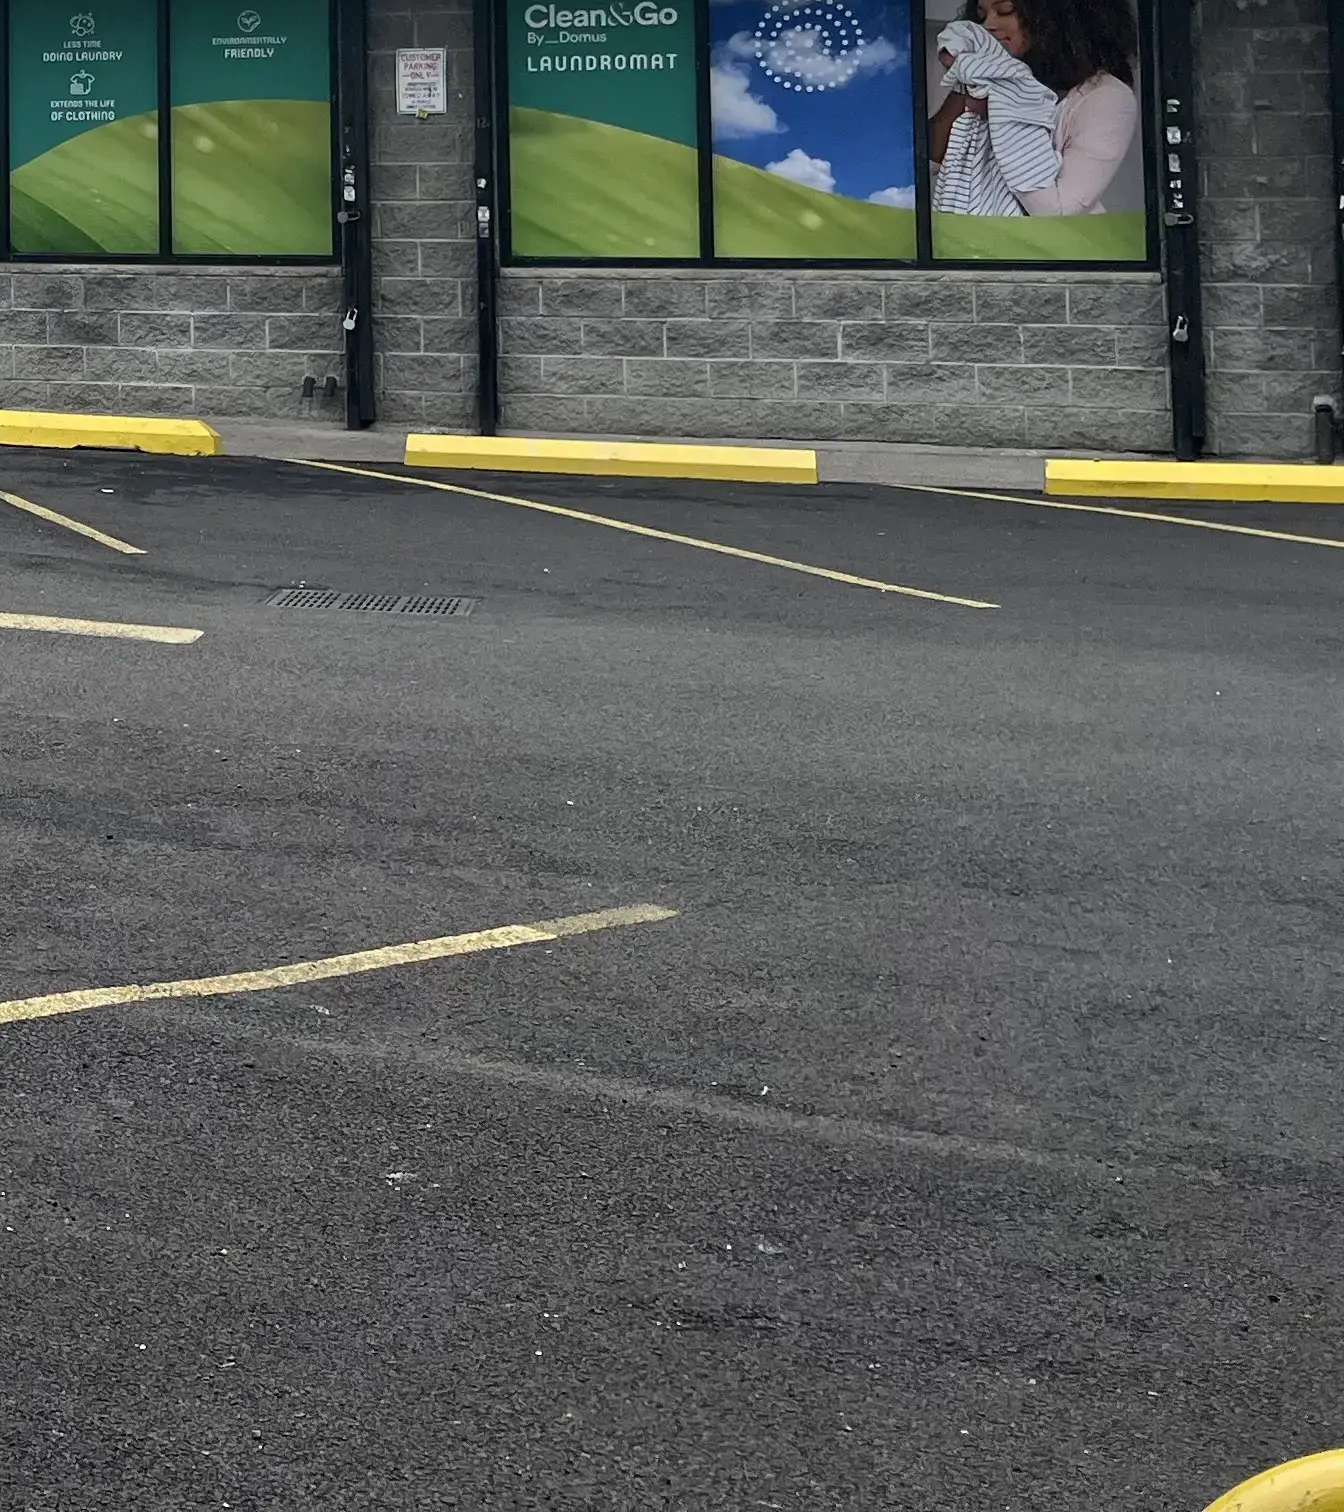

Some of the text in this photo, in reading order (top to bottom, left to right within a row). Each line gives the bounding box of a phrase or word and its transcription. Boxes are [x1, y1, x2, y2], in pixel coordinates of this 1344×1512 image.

[524, 0, 678, 29] Clean&Go
[63, 39, 102, 49] LESS TIME
[42, 51, 123, 62] DOING LAUNDRY
[224, 47, 275, 59] FRIENDLY
[527, 53, 679, 72] LAUNDROMAT
[50, 99, 115, 108] EXTENDS THE LIFE
[50, 110, 116, 122] OF CLOTHING
